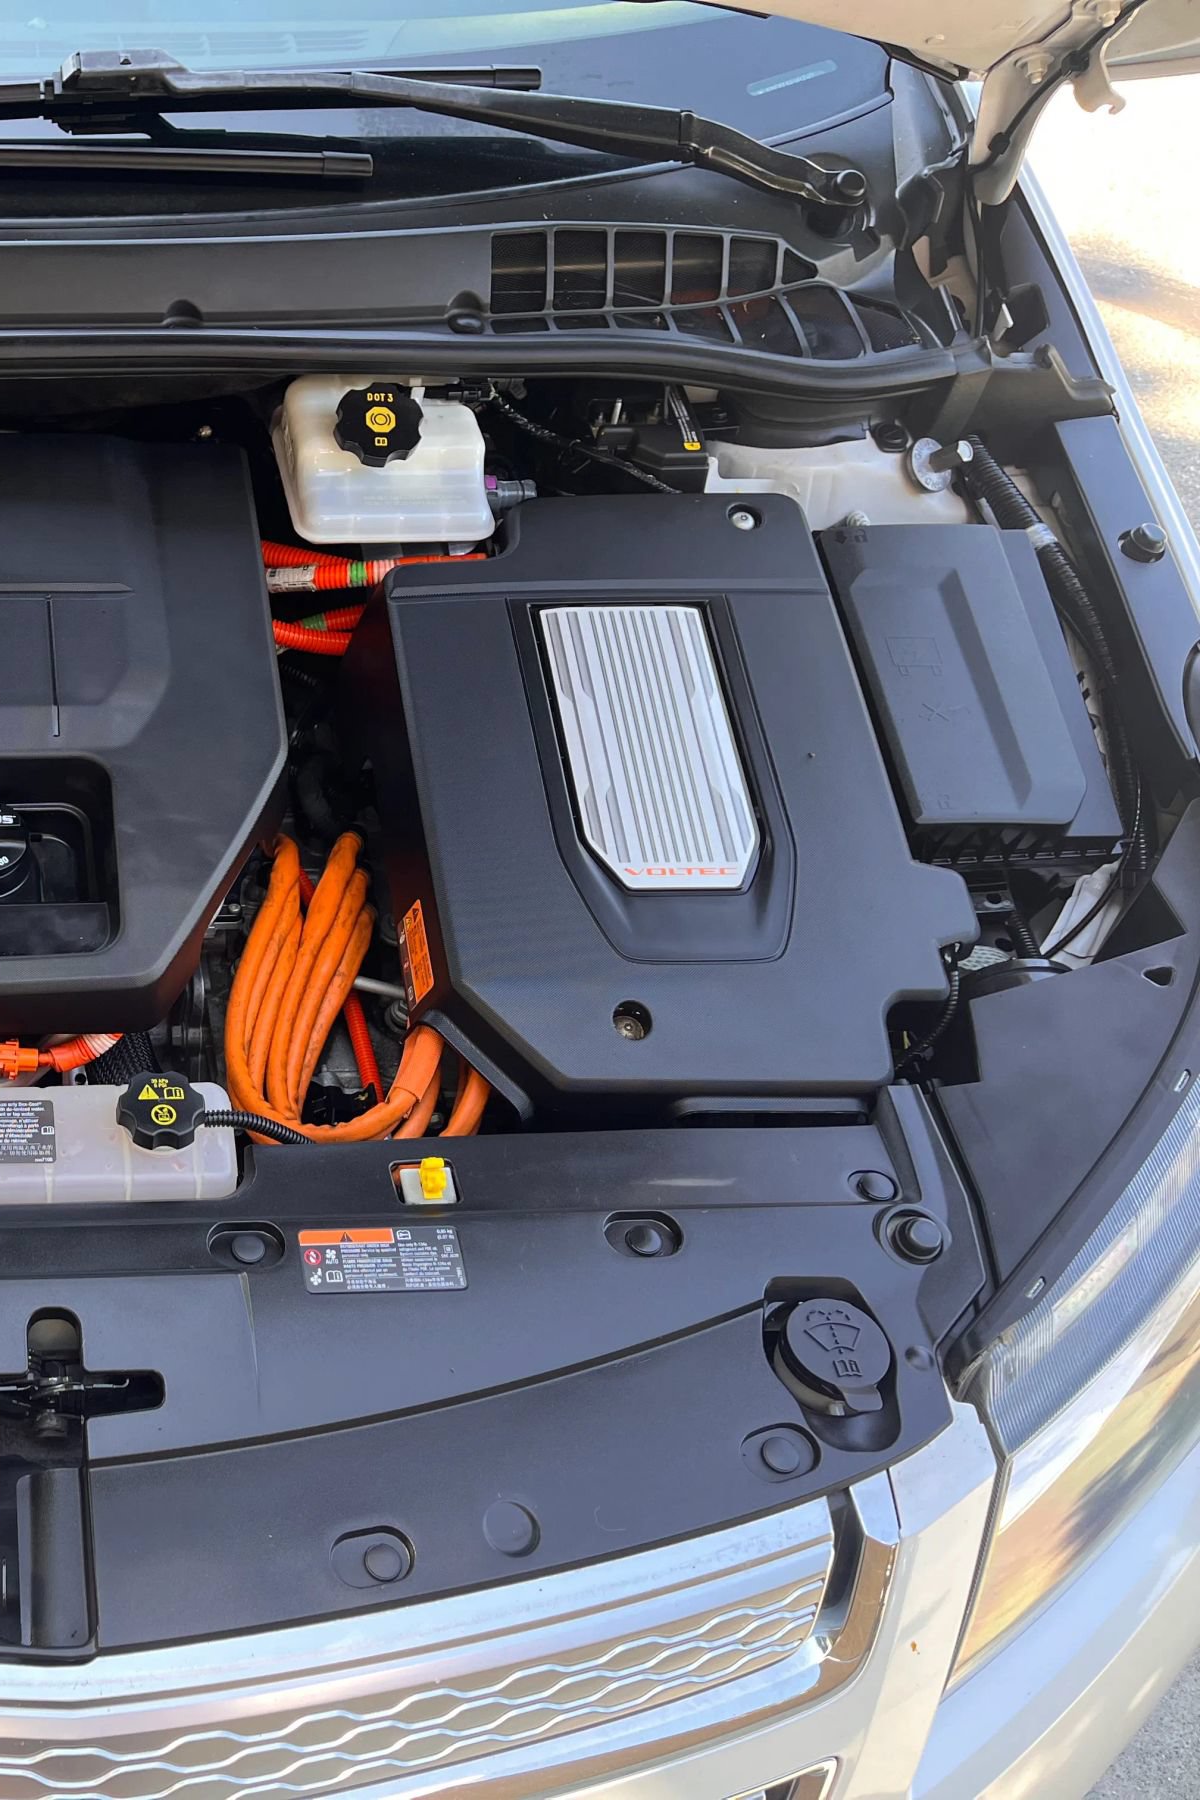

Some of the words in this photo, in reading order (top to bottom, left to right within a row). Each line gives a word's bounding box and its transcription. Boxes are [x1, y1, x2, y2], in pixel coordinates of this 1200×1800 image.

[367, 393, 385, 401] DOT
[387, 394, 394, 402] 3
[624, 867, 737, 876] VOLTEC
